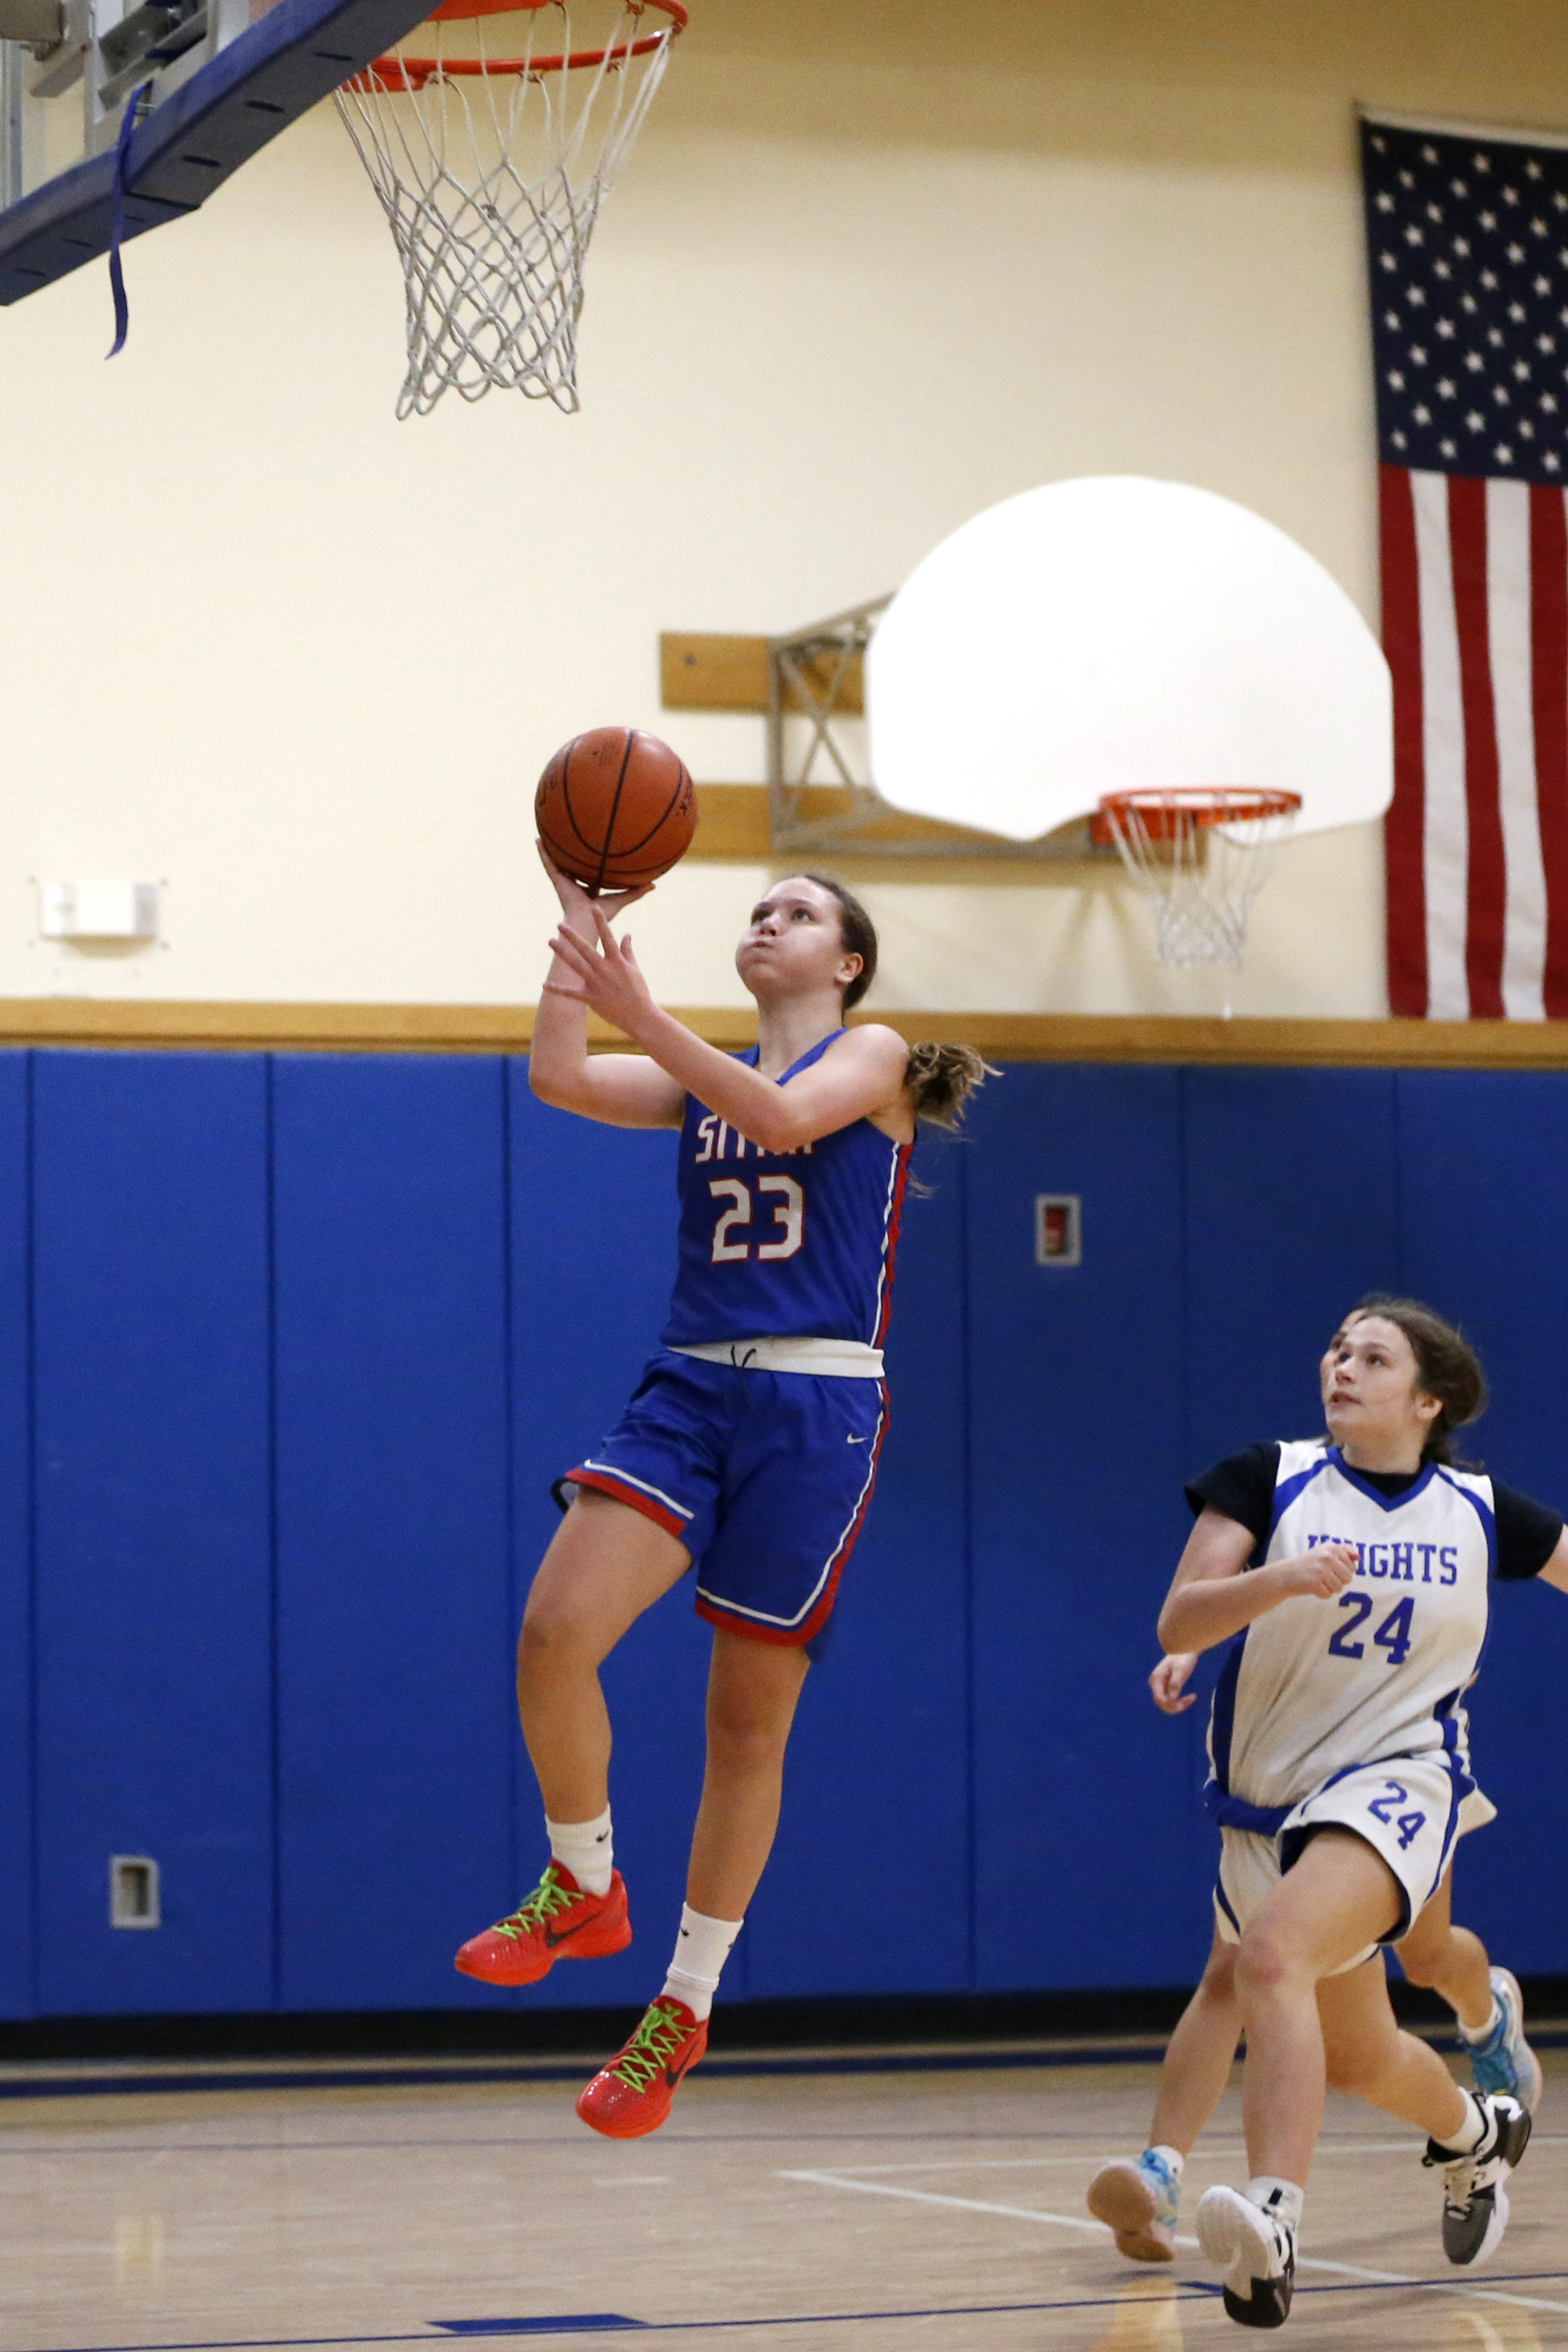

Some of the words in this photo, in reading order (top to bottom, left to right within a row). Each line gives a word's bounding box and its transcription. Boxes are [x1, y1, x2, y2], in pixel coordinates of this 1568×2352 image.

[708, 1175, 805, 1264] 23
[1308, 1534, 1458, 1586] IGHTS
[1328, 1591, 1415, 1665] 24
[1368, 1782, 1426, 1851] 24
